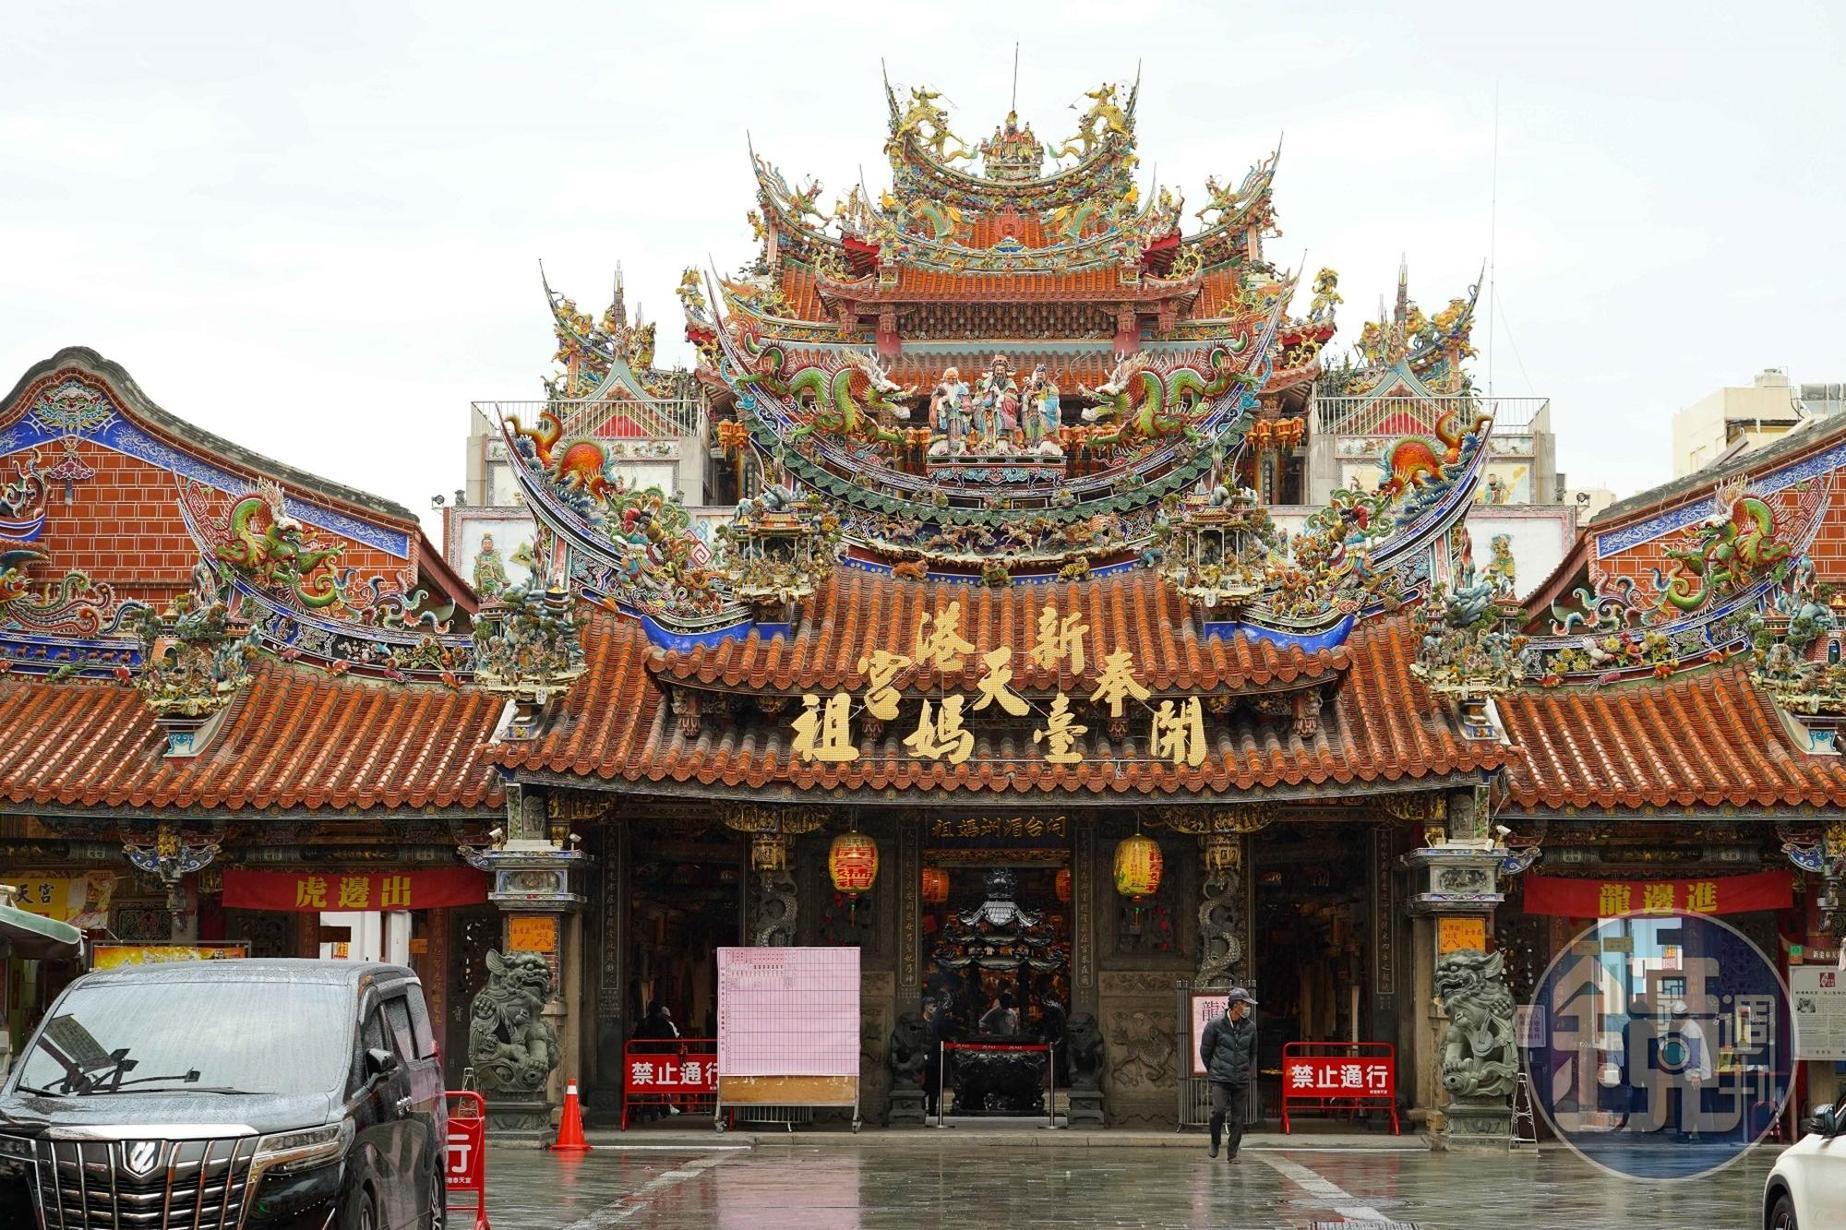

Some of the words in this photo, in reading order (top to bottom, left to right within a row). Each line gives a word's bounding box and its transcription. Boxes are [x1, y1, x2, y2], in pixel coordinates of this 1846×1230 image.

[296, 875, 413, 908] 虎邊出
[1599, 881, 1718, 916] 龍邊進
[1202, 1000, 1228, 1022] 龍
[632, 1061, 718, 1086] 禁止通行
[1291, 1064, 1389, 1089] 禁止通行
